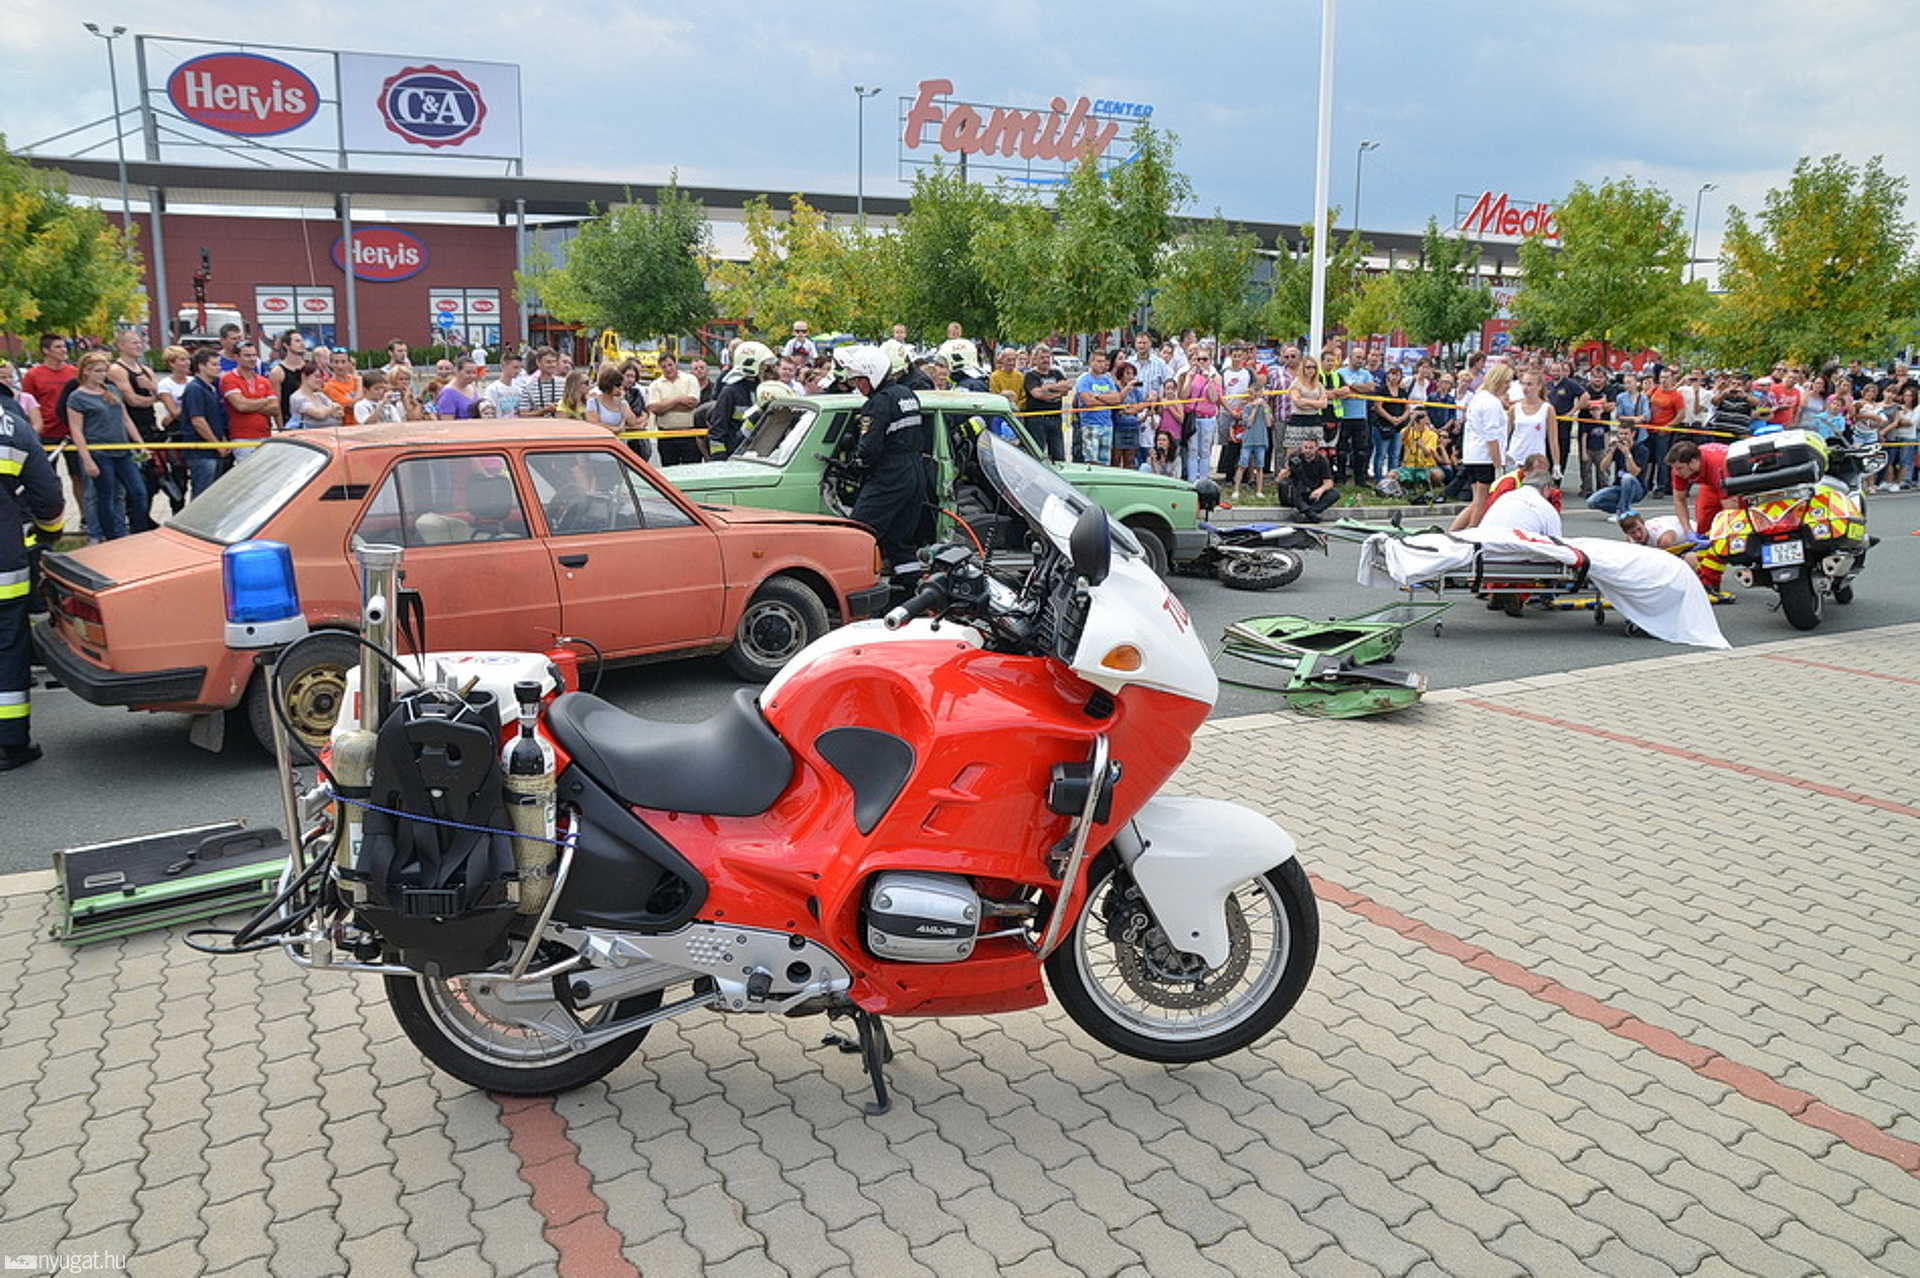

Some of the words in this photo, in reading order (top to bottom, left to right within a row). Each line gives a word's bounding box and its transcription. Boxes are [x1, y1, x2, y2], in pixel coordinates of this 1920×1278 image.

[184, 70, 307, 120] Hervis
[397, 87, 468, 126] C&A
[1094, 99, 1154, 117] CENTER
[904, 79, 1119, 164] Family
